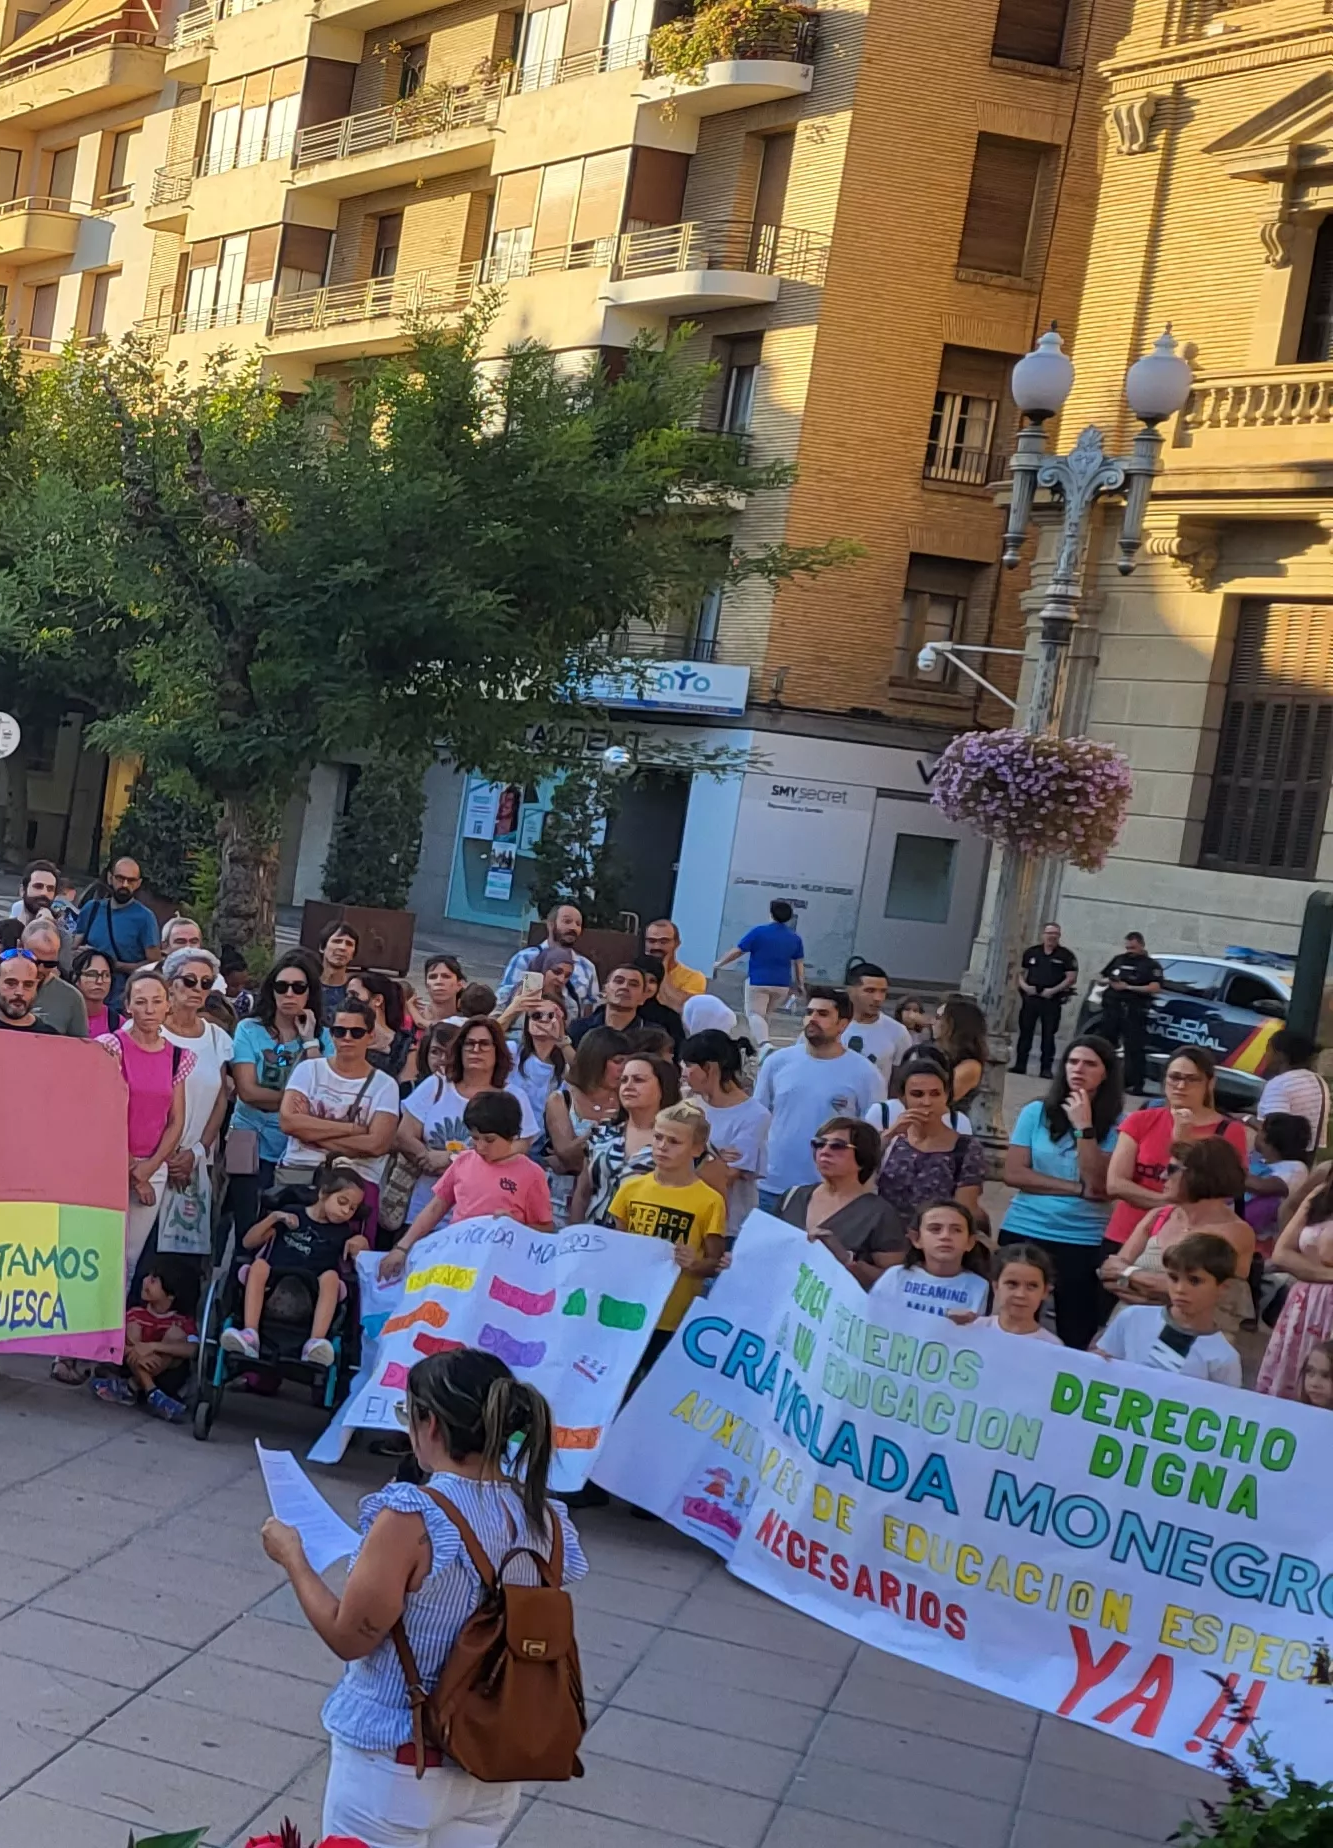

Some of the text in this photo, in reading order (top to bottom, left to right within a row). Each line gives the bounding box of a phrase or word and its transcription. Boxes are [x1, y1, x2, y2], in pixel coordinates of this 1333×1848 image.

[1146, 1024, 1228, 1052] NACIONAL
[904, 1281, 969, 1303] DREAMING
[821, 1352, 1044, 1460] EDUCACION
[1088, 1433, 1259, 1520] DIGNA
[1049, 1371, 1298, 1472] DERECHO
[754, 1508, 968, 1642] NECESARIOS
[812, 1483, 857, 1535] DE
[882, 1513, 1133, 1635] EDUCACION
[1158, 1602, 1333, 1687] ESPEC
[983, 1468, 1333, 1620] MONEGR
[1056, 1624, 1175, 1738] YA
